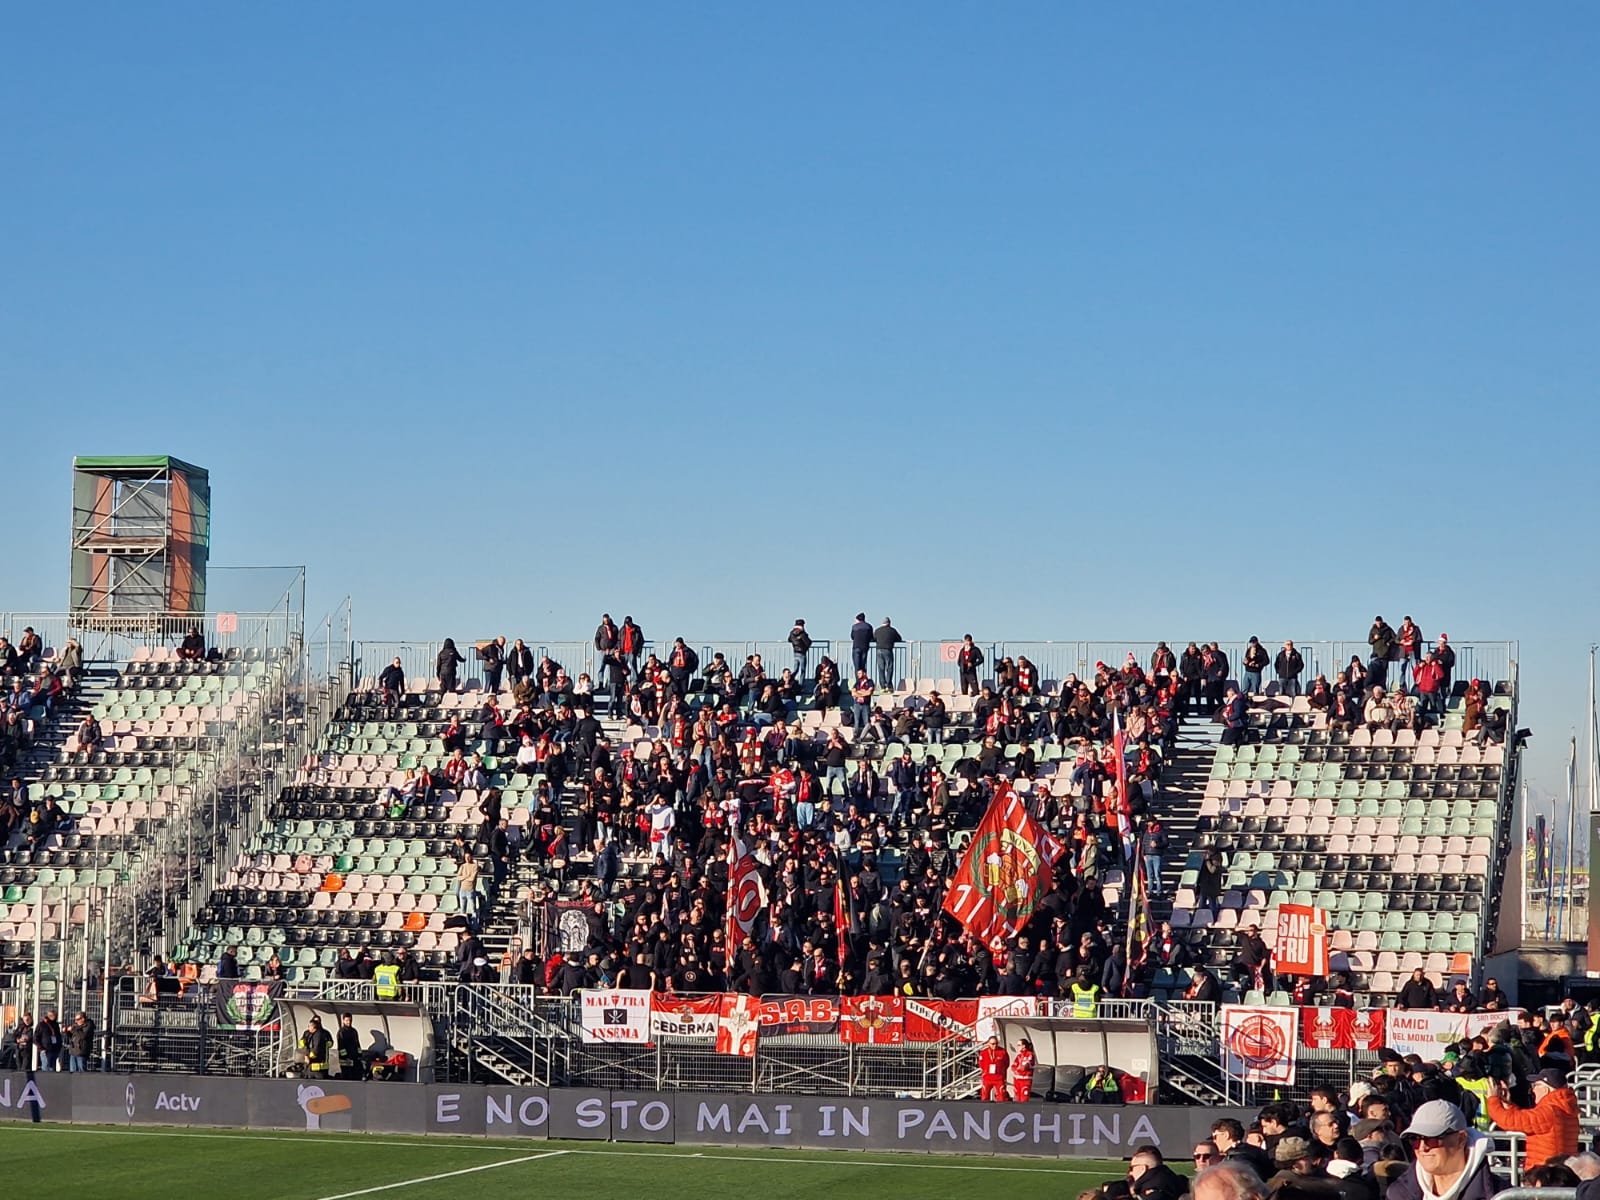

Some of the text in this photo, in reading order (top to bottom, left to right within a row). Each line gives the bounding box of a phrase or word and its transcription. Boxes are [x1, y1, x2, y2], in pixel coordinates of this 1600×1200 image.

[221, 616, 231, 628] 4
[947, 645, 957, 660] 6
[1278, 913, 1310, 938] SAN
[1277, 937, 1309, 964] FRU
[620, 996, 646, 1008] TRA
[892, 998, 902, 1008] 9
[652, 1019, 716, 1036] CEDERNA
[1392, 1017, 1430, 1031] AMICI
[592, 1027, 640, 1040] INSEMA
[890, 1031, 901, 1042] 2
[1407, 1032, 1435, 1043] MONZA
[154, 1091, 201, 1112] Actv
[436, 1094, 1162, 1147] E NO STO MAI IN PANCHINA
